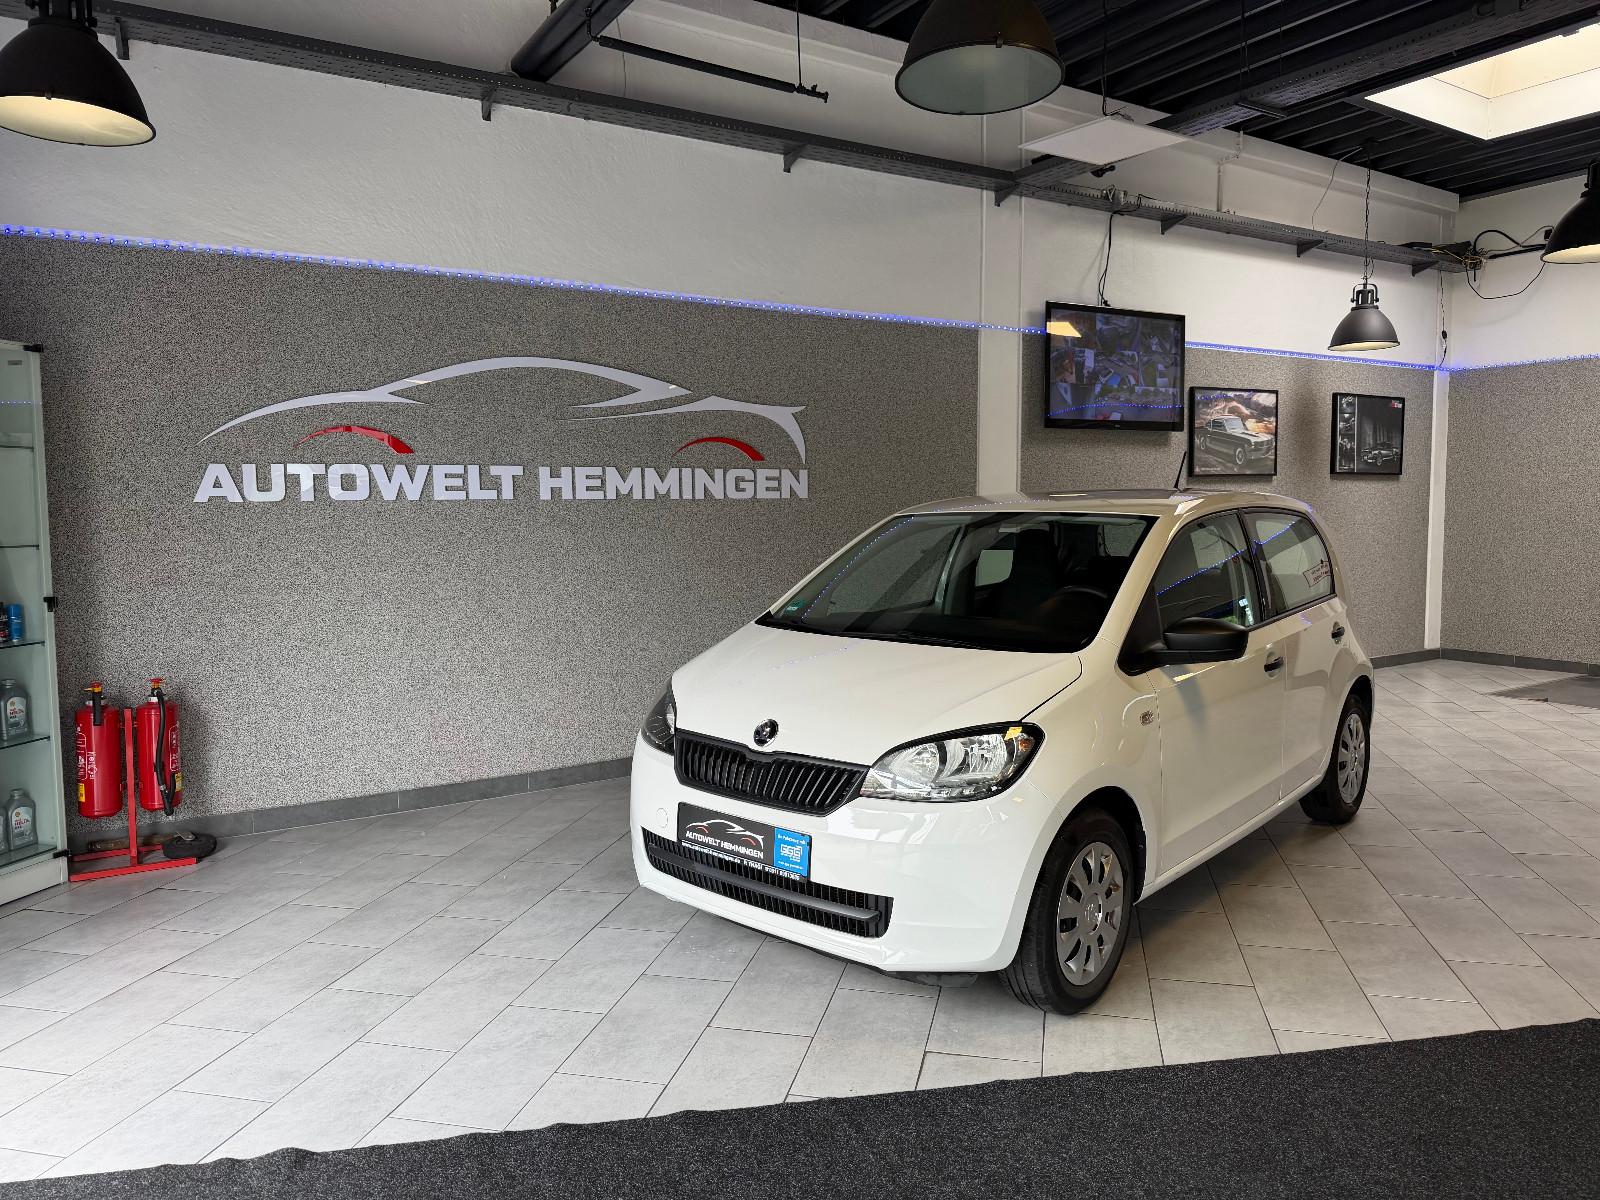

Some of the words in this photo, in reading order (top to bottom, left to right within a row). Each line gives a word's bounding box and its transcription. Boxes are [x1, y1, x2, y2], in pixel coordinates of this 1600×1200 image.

[193, 463, 524, 503] AUTOWELT
[538, 466, 809, 500] HEMMINGEN
[685, 830, 721, 846] AUTOWELT
[721, 840, 764, 859] HEMMINGEN
